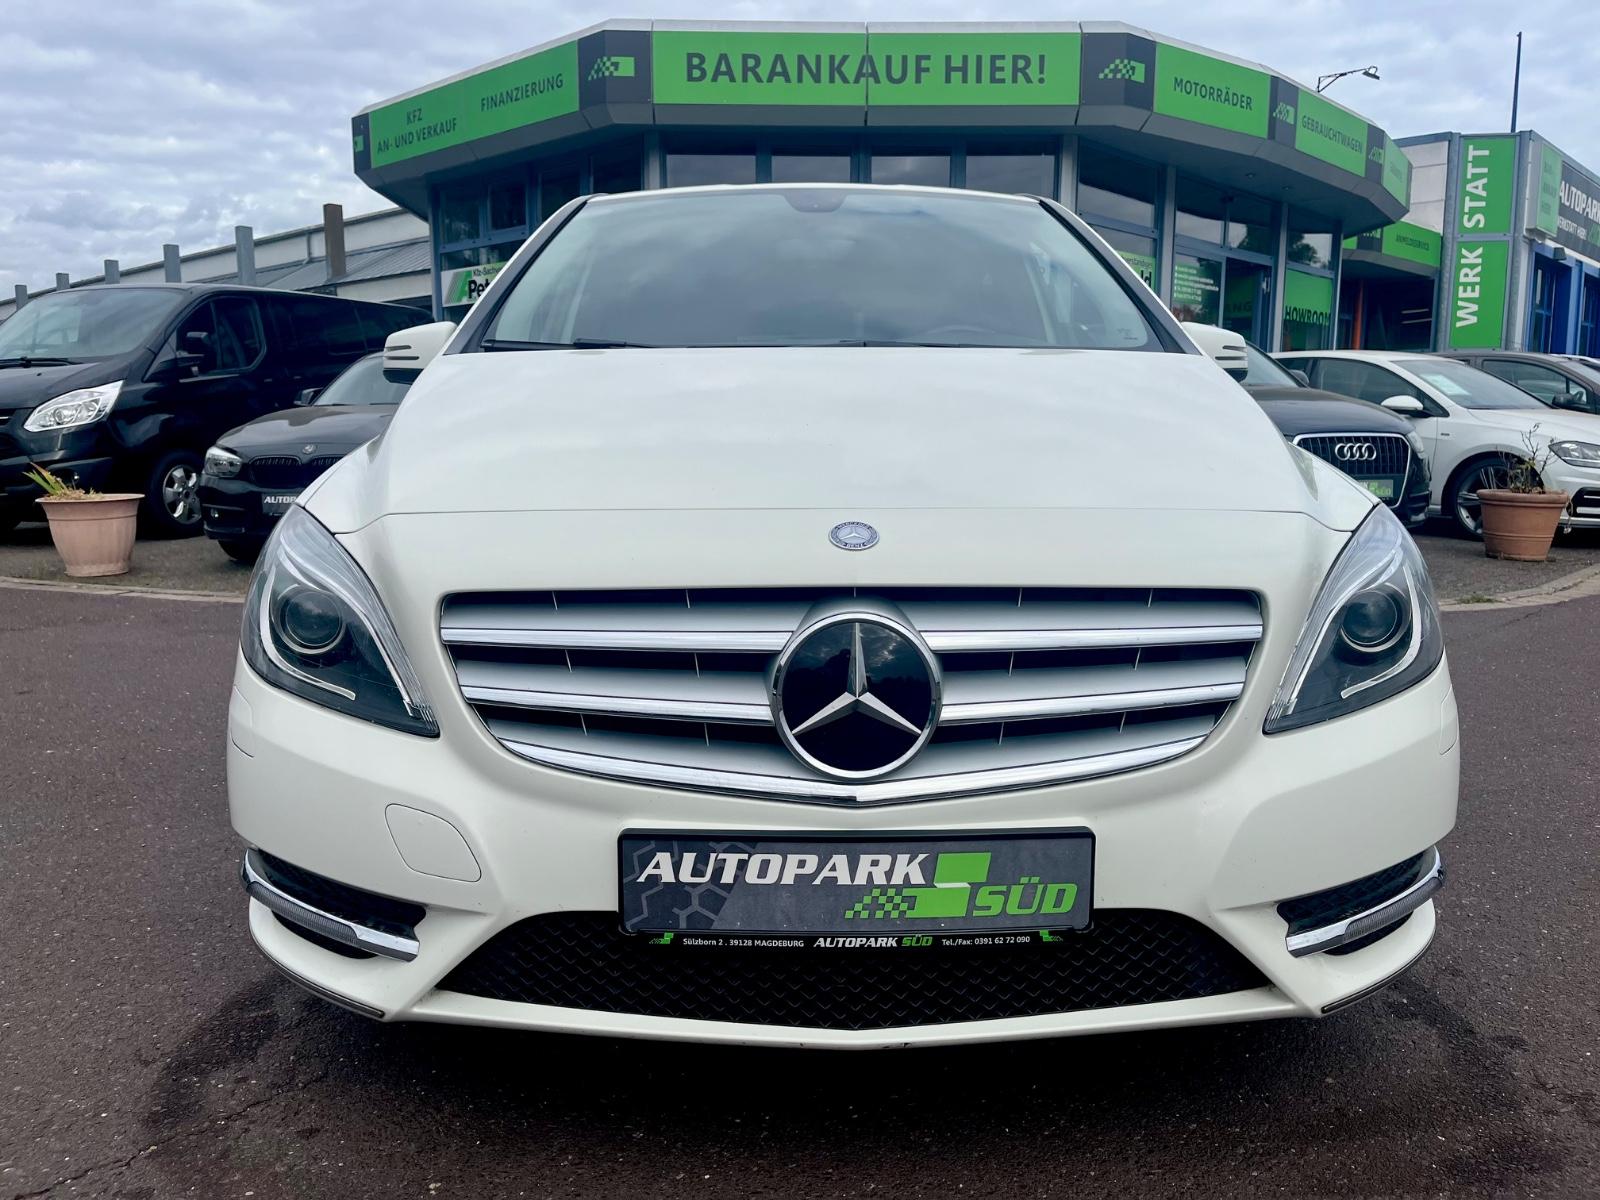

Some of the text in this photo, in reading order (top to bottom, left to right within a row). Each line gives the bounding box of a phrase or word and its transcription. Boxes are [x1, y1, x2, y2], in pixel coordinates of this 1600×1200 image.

[685, 52, 1046, 84] BARANKAUF HIER!
[481, 73, 564, 112] FINANZIERUNG
[1173, 76, 1253, 111] MOTORRÄDER
[406, 108, 423, 125] KFZ
[377, 117, 457, 154] AN- UND VERKAUF
[1301, 114, 1363, 154] GEBRAUCHTWAGEN
[1456, 144, 1490, 328] WERK STATT
[637, 852, 931, 886] AUTOPARK
[972, 876, 1078, 917] SÜD
[683, 938, 717, 946] Sülzborn
[718, 938, 723, 946] 2
[729, 938, 753, 947] 39128
[754, 939, 805, 948] MAGDEBURG
[813, 934, 933, 948] AUTOPARK SÜD
[942, 936, 1031, 946] Tel./Fax: 0391 62 72 090
